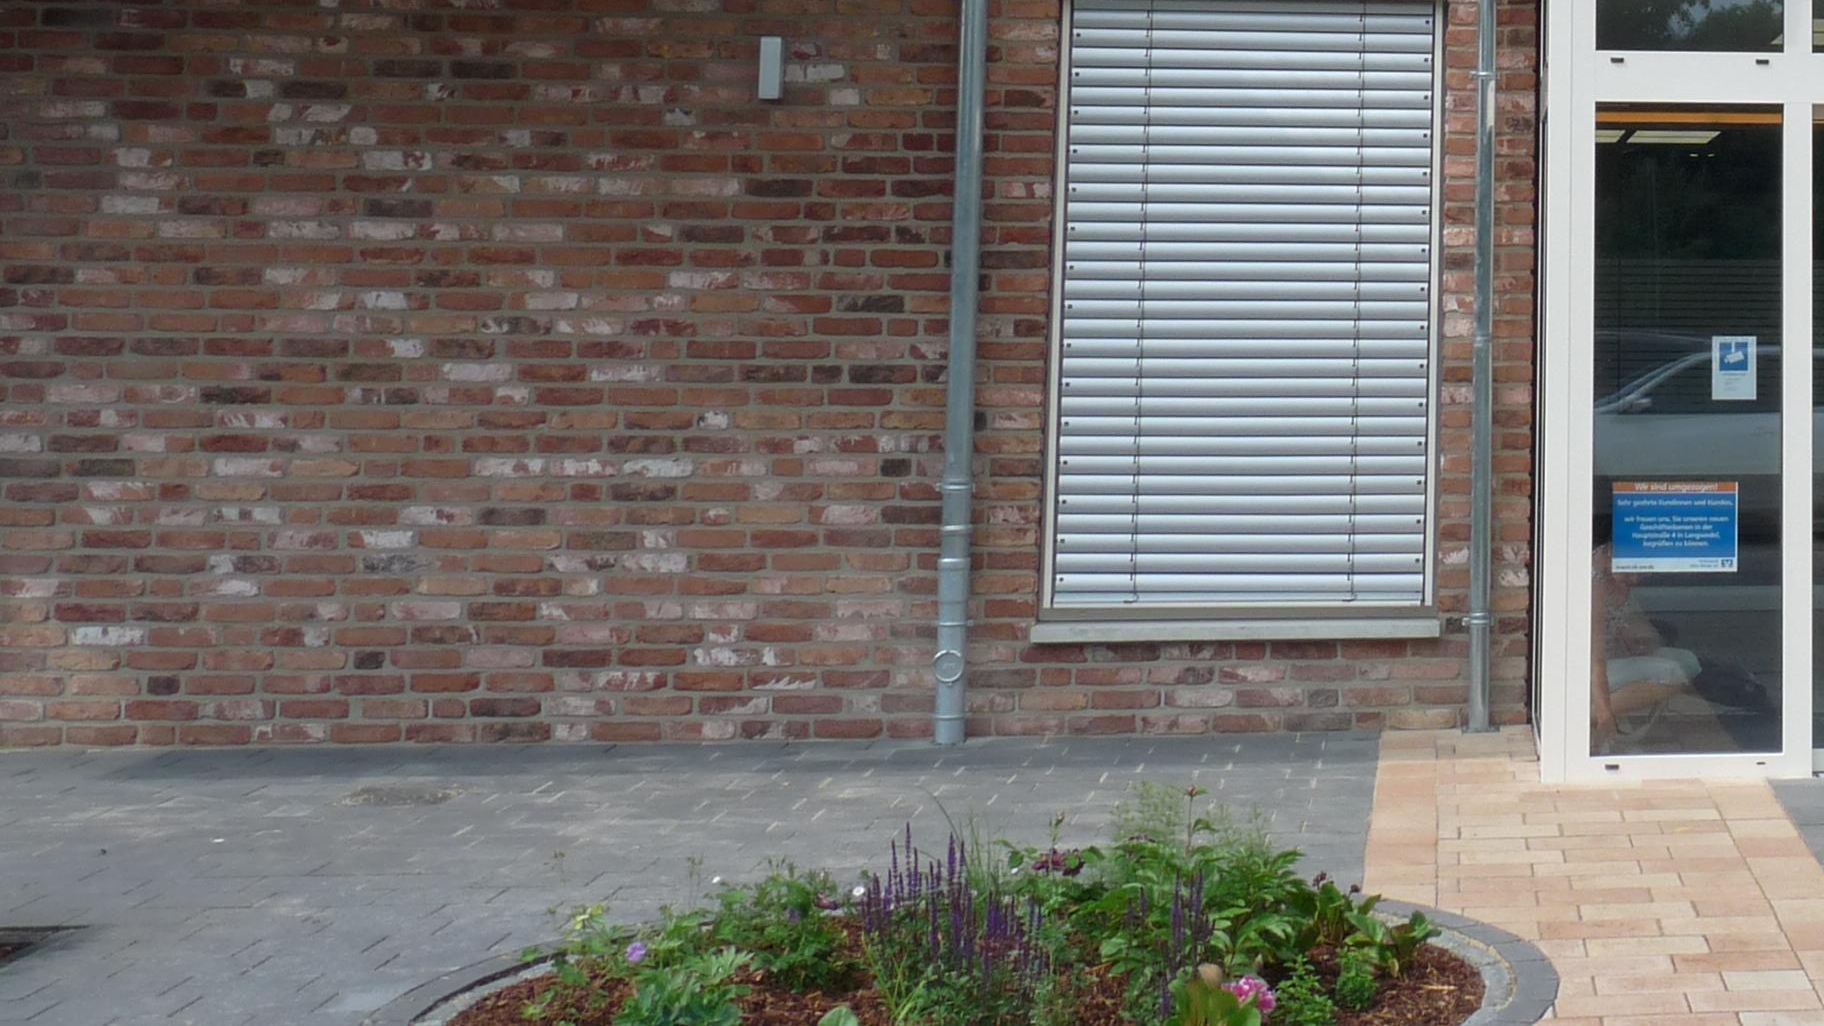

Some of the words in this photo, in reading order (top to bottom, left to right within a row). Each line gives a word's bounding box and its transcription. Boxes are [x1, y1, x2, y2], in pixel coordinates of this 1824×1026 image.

[1634, 482, 1649, 491] Wir
[1650, 482, 1667, 491] sind
[1668, 482, 1718, 493] umgezogen!
